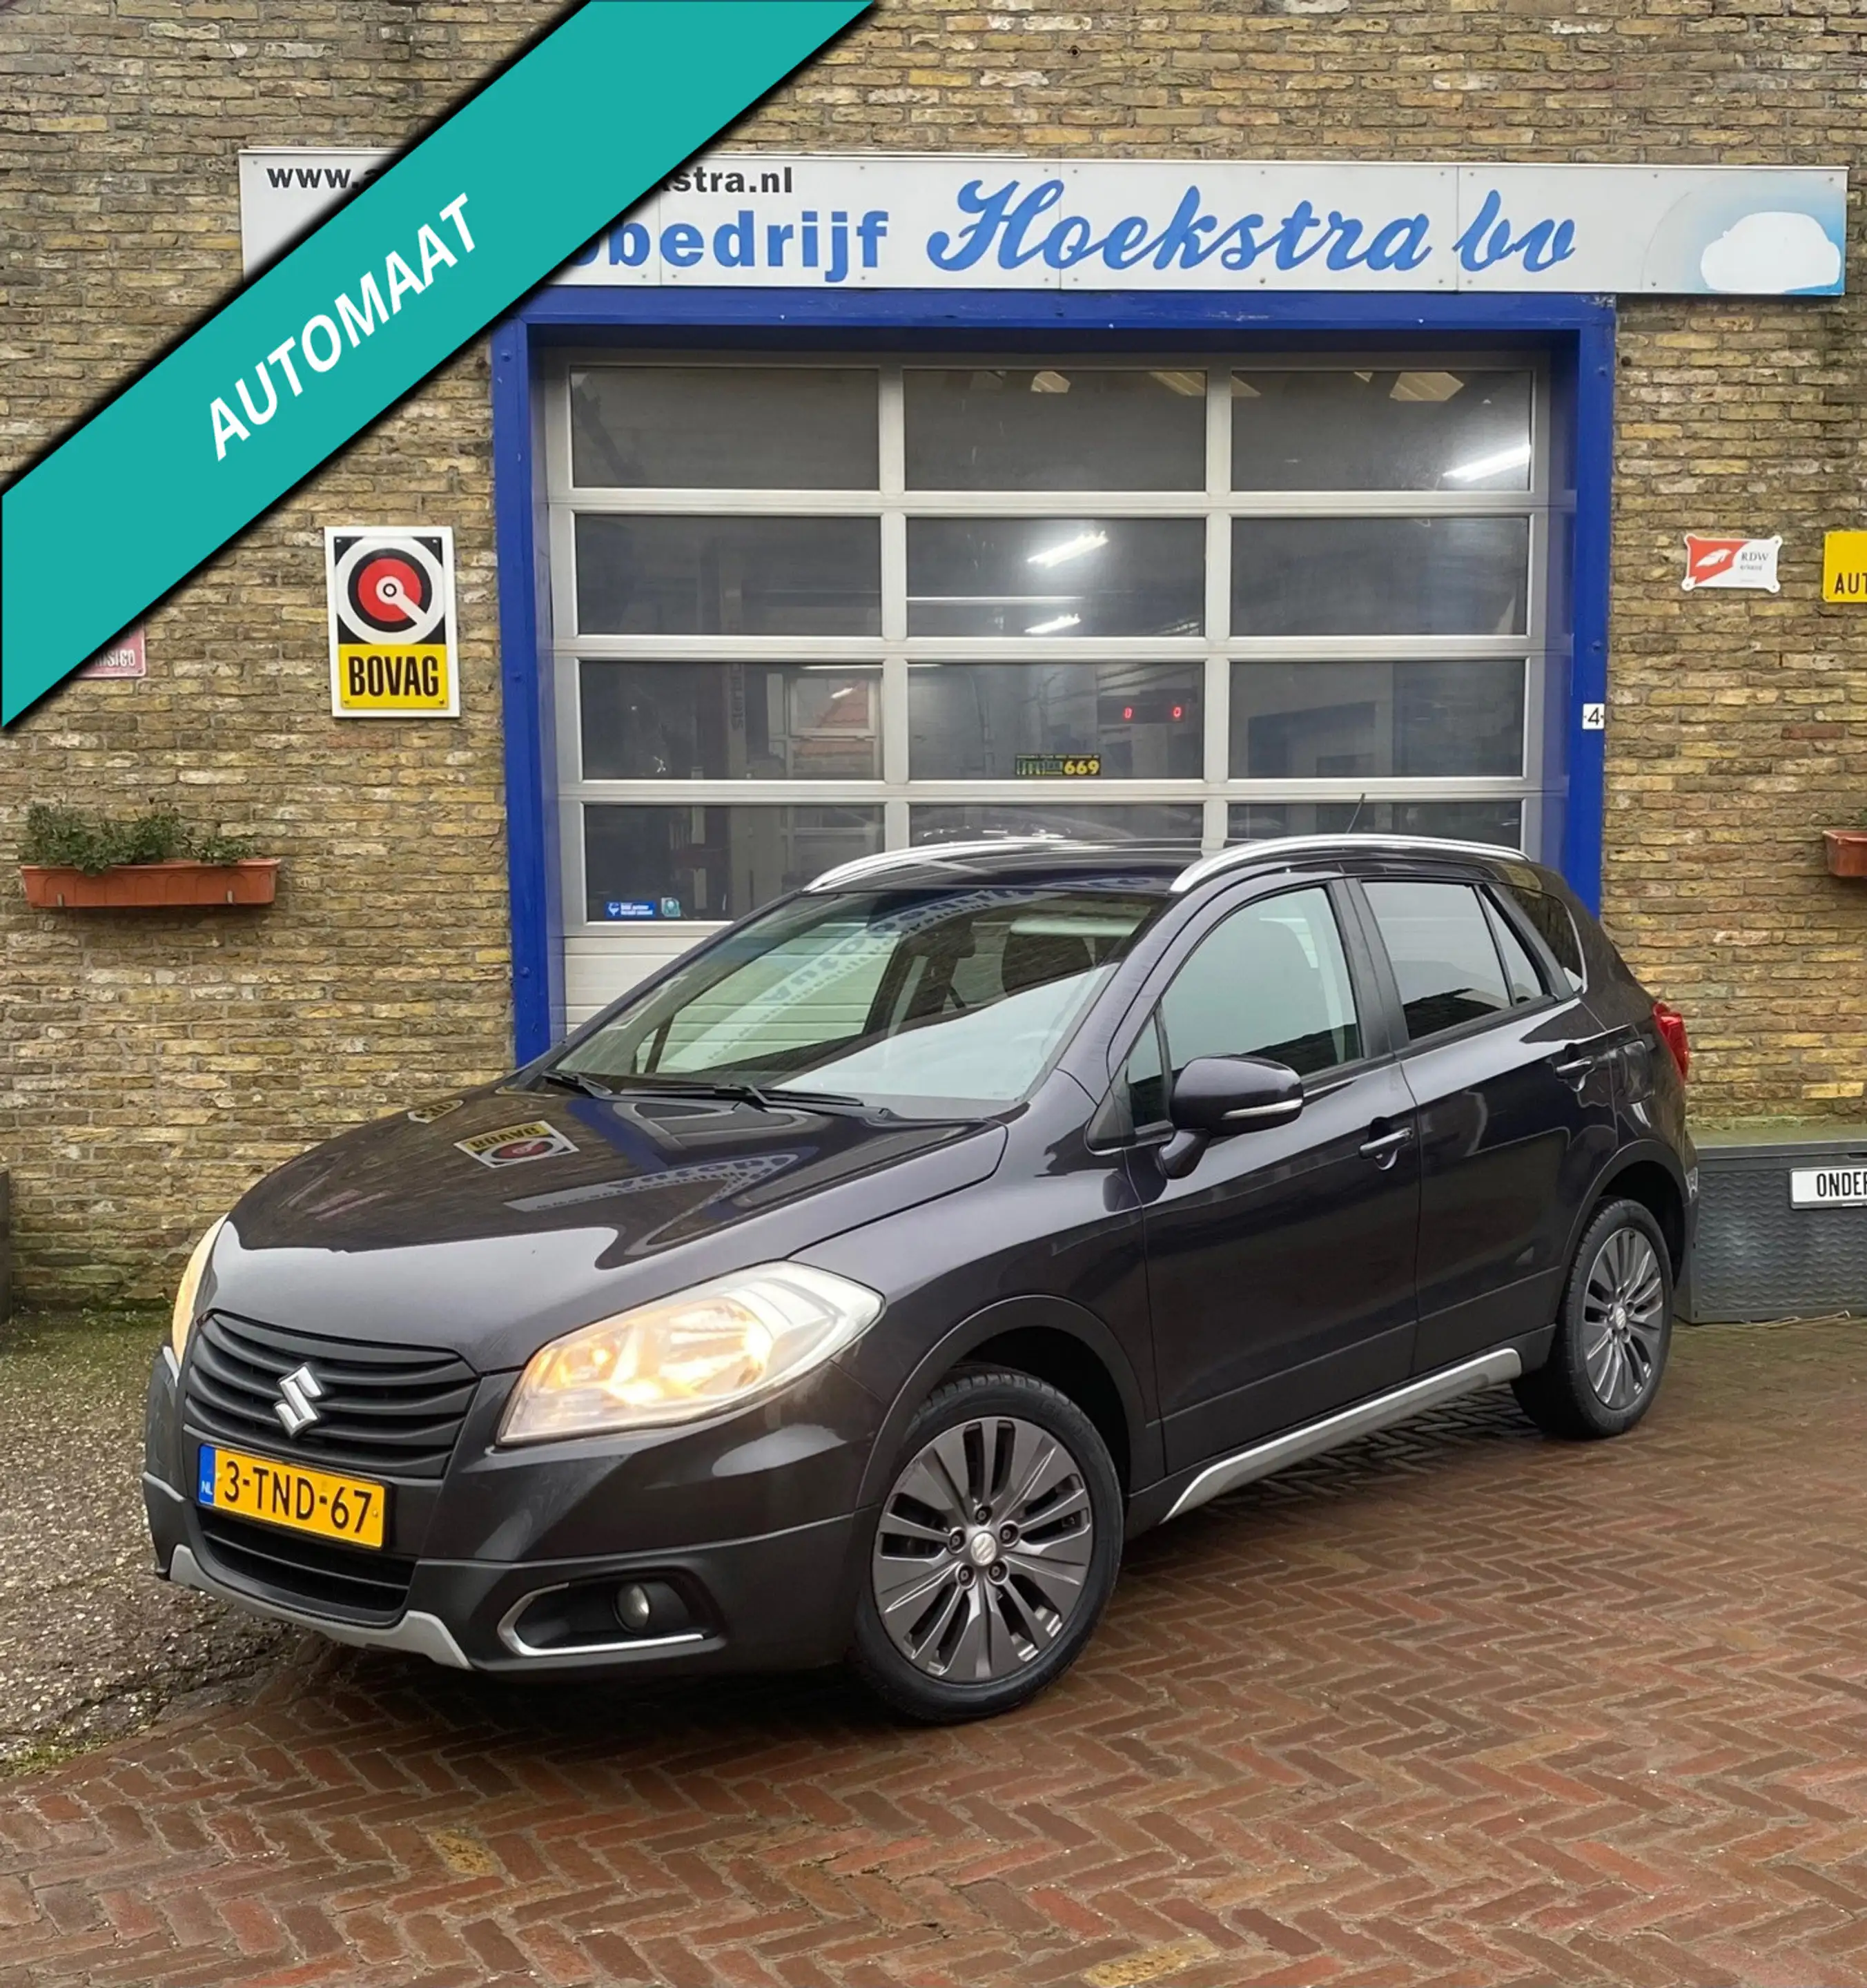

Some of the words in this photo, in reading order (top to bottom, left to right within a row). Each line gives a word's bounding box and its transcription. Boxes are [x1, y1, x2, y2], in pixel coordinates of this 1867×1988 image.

[661, 167, 792, 193] stra.nl
[927, 180, 1432, 271] Hoekstra
[1452, 190, 1576, 272] bv
[1741, 552, 1768, 561] RDW
[348, 656, 439, 697] BOVAG
[1587, 706, 1600, 725] 4
[1064, 760, 1099, 774] 669
[201, 1480, 213, 1496] NL
[224, 1460, 373, 1534] 3-TND-67
